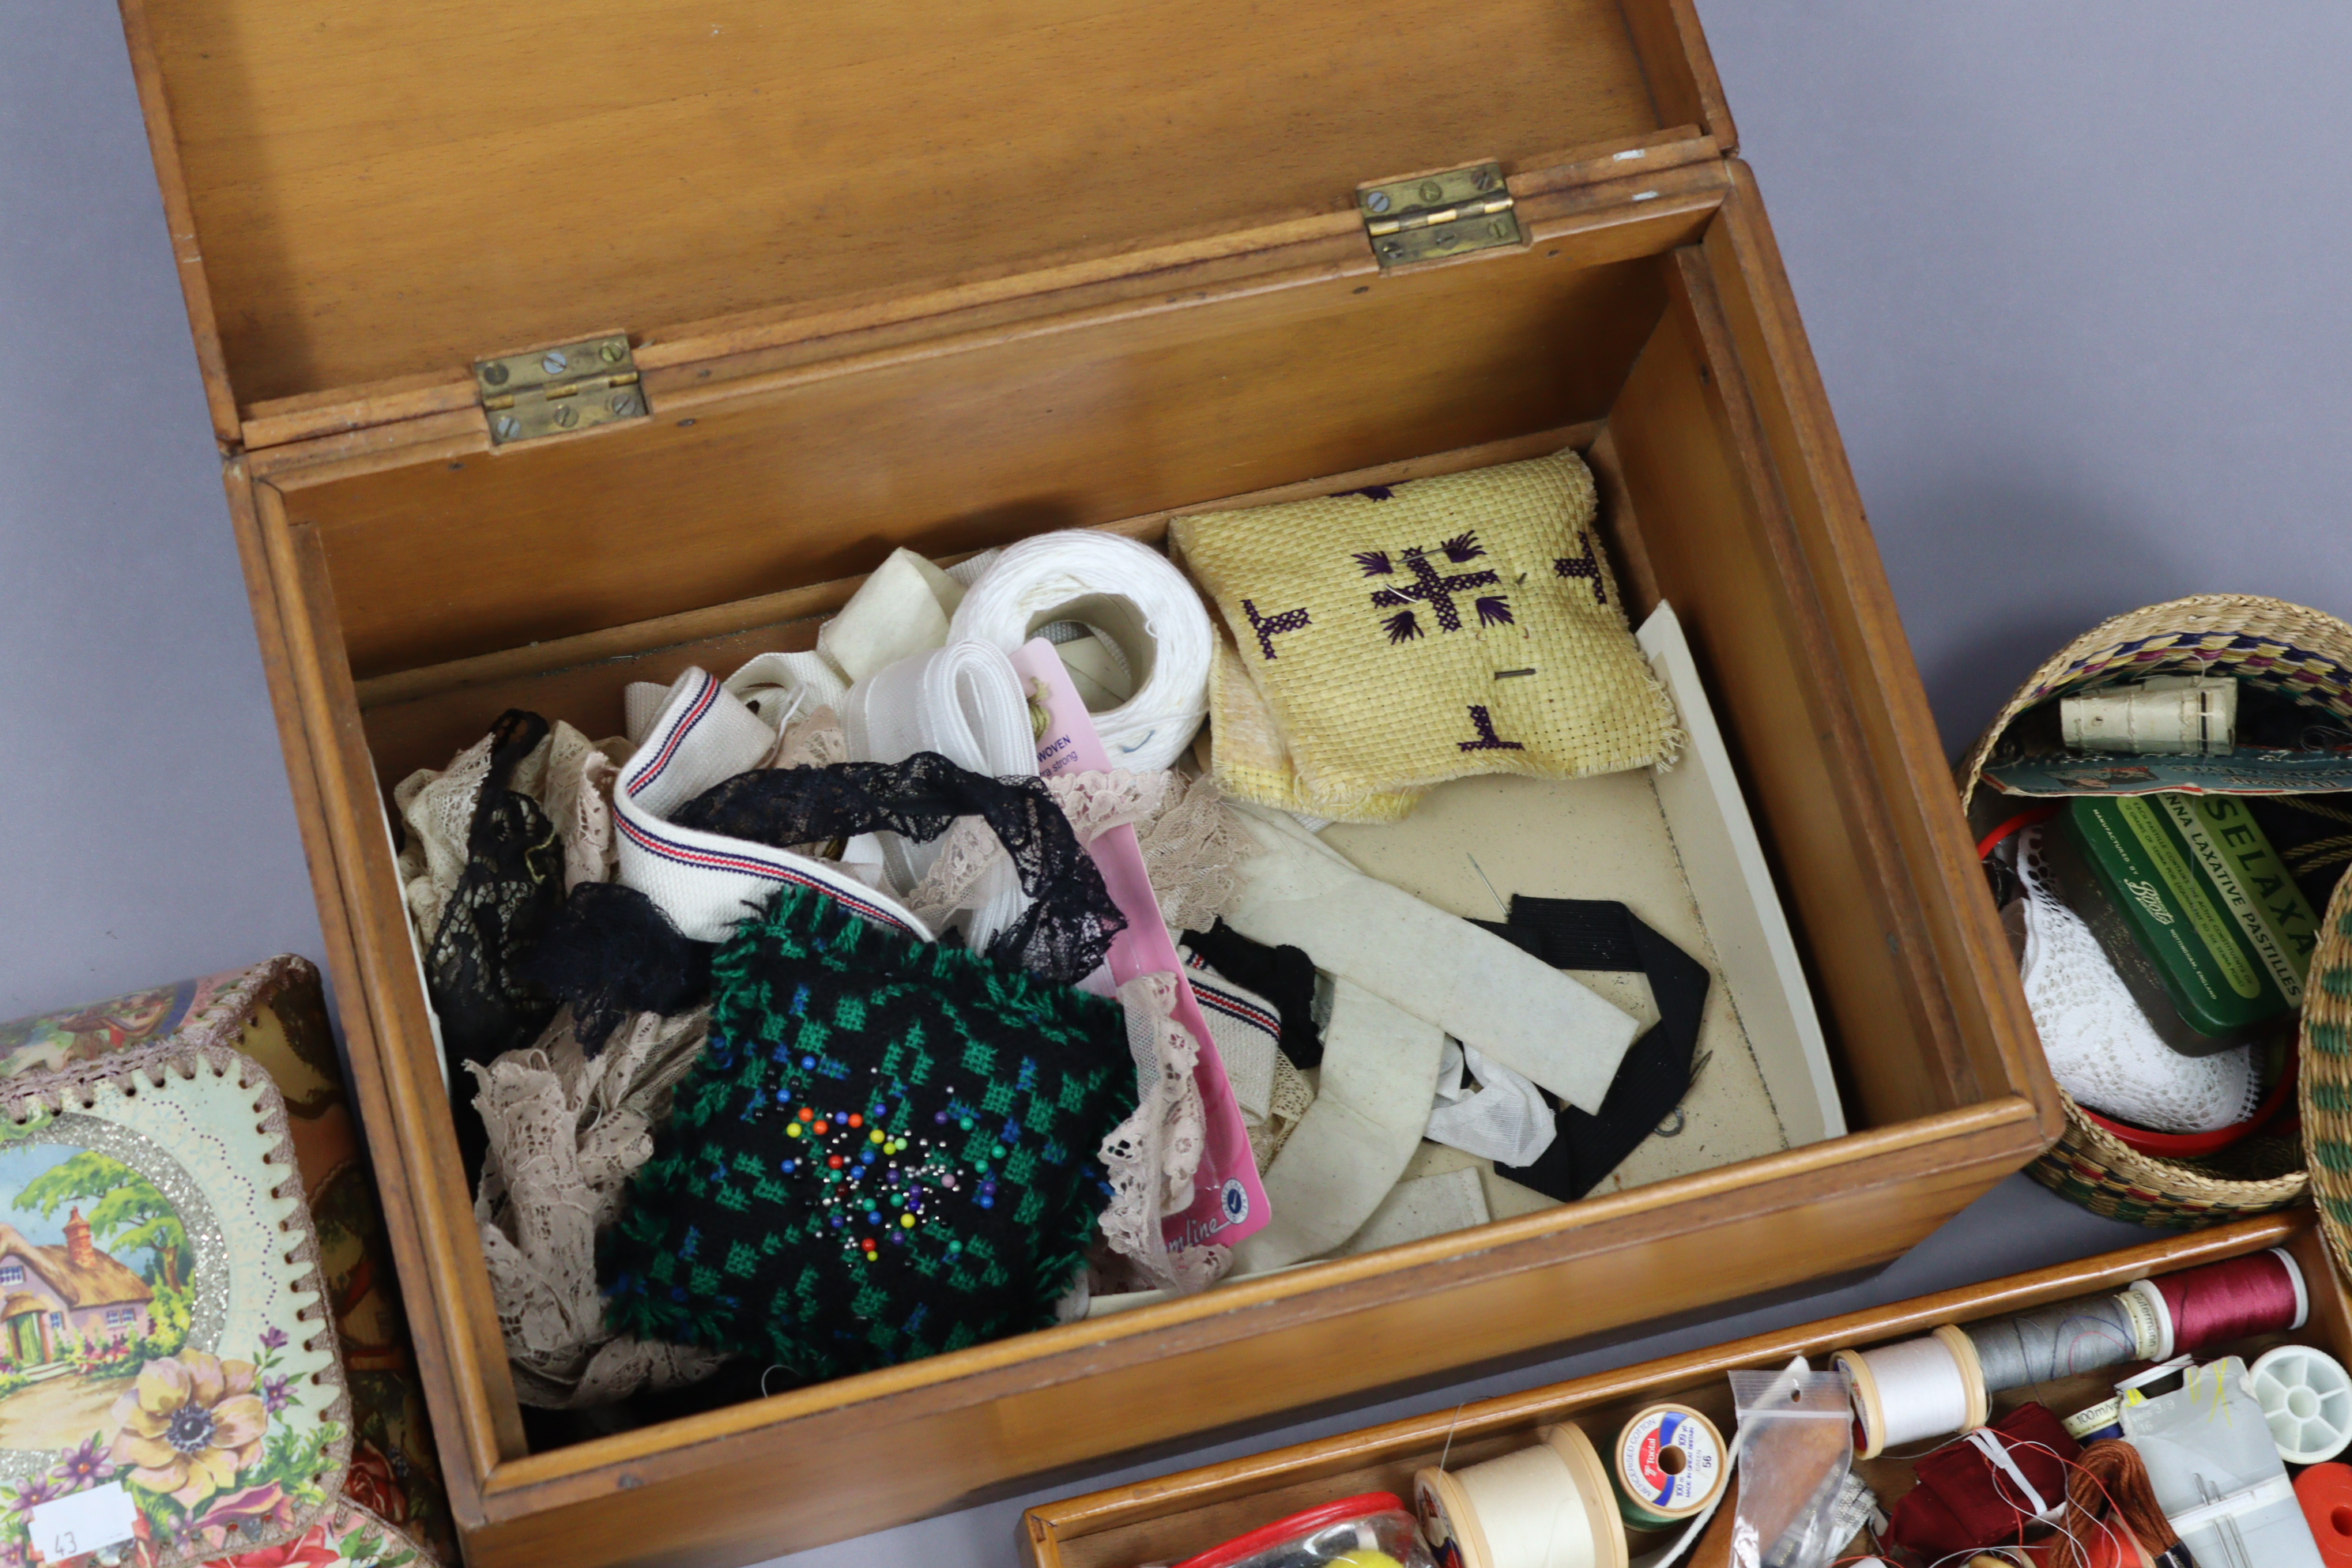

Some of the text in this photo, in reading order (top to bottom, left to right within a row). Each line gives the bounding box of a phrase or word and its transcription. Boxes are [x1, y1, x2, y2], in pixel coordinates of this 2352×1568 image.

[1037, 734, 1071, 763] WOVEN
[1052, 751, 1078, 772] strong
[2093, 808, 2139, 875] MANUFACTURED BY
[2130, 812, 2146, 834] GRAINS
[2145, 835, 2154, 843] OF
[2153, 846, 2167, 865] SENNA
[2202, 923, 2210, 933] TO
[2217, 947, 2231, 967] SENNA
[2230, 968, 2245, 987] PODS)
[2135, 802, 2147, 820] EACH
[2148, 821, 2167, 849] PASTILLE
[2167, 851, 2189, 884] CONTAINS
[2198, 900, 2214, 922] ACTIVE
[2214, 925, 2245, 973] CONSTITUENTS
[2203, 797, 2318, 957] SELAXA
[2124, 879, 2175, 925] Boots
[2191, 833, 2246, 906] LAXATIVE
[2241, 913, 2301, 997] PASTILLES
[2170, 929, 2218, 1000] NOTTINGHAM, ENGLAND
[1167, 1218, 1227, 1253] mline
[1626, 1419, 1657, 1498] MERCERISED COTTON
[1646, 1438, 1657, 1464] Tootal
[1678, 1434, 1687, 1446] 109
[1702, 1455, 1712, 1468] 56
[55, 1531, 77, 1557] 43
